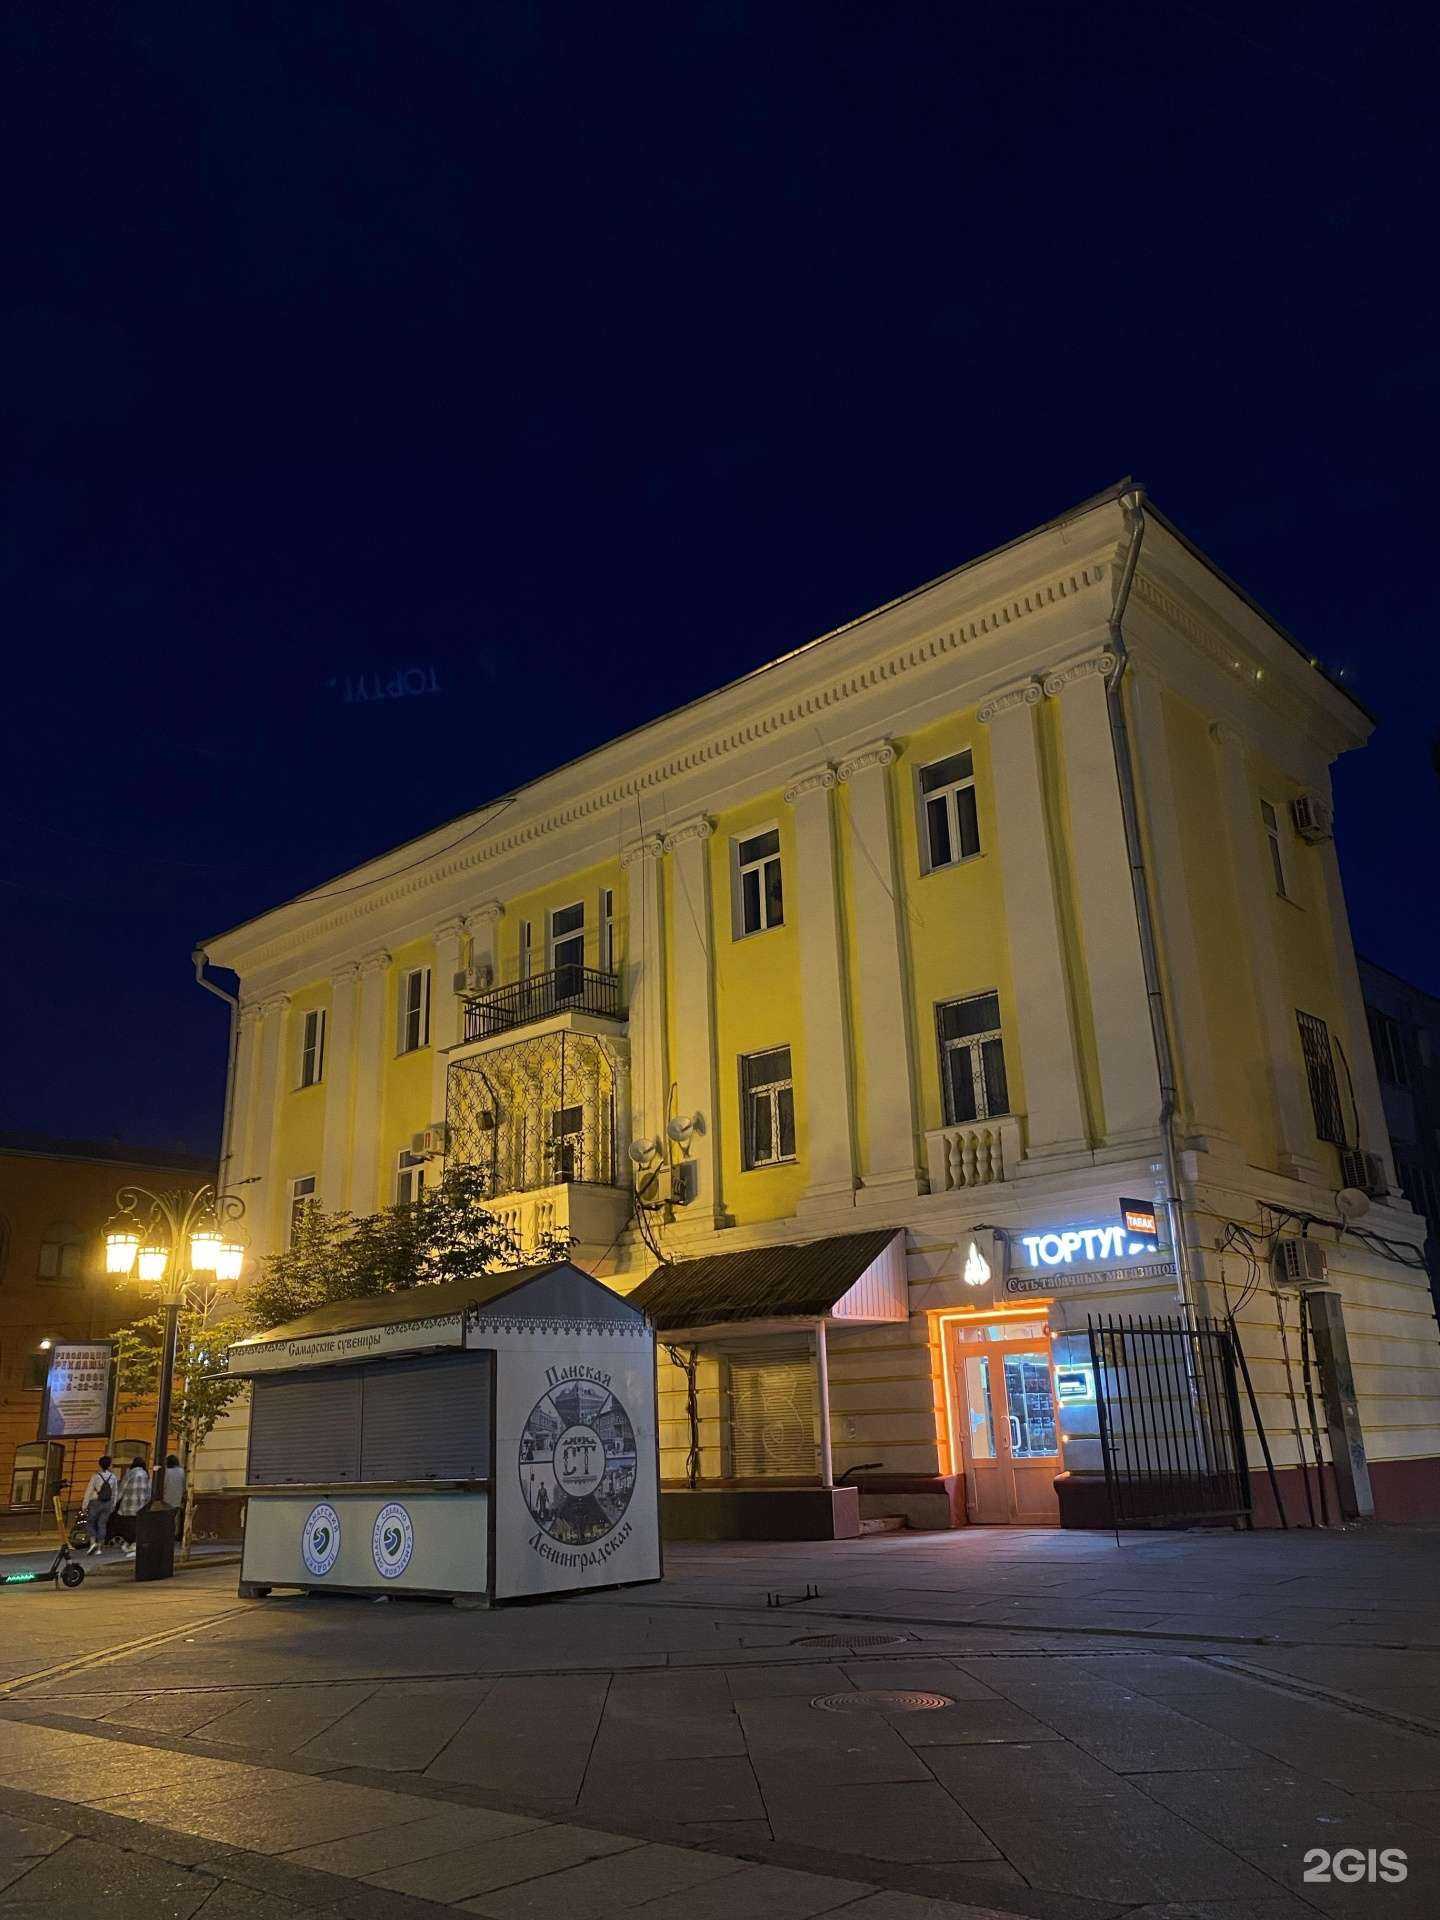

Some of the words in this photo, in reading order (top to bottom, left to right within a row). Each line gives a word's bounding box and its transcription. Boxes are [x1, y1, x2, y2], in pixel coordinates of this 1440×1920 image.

[1007, 1277, 1042, 1294] Сеть
[1042, 1272, 1104, 1290] табачных
[288, 1341, 336, 1358] Самарские
[337, 1333, 382, 1354] сувениры
[544, 1364, 613, 1387] Панская
[529, 1520, 633, 1573] Ленинградская
